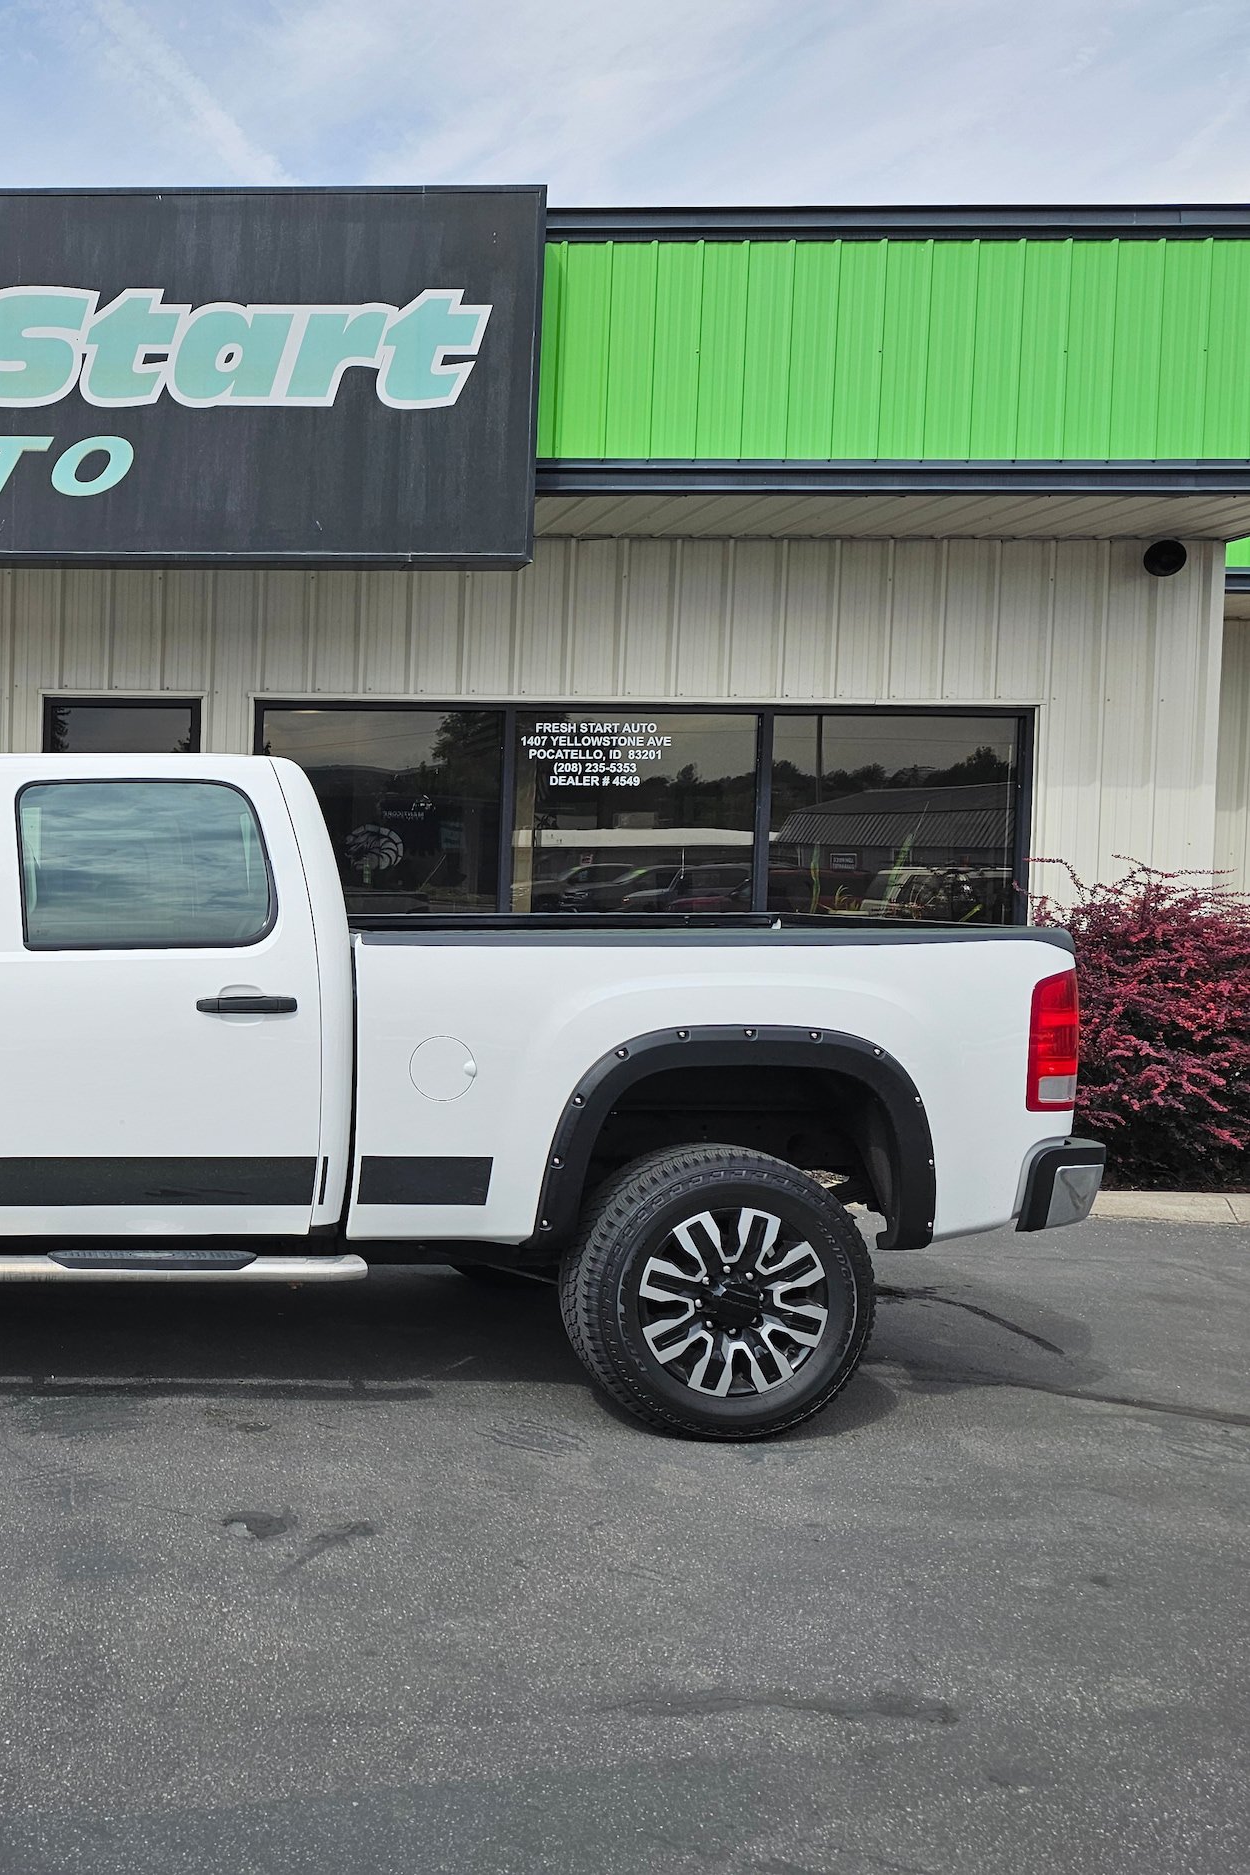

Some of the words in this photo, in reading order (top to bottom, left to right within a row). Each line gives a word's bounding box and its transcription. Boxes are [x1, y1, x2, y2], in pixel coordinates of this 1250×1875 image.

[535, 723, 576, 733] FRESH
[579, 723, 620, 733] START
[621, 723, 657, 733] AUTO
[520, 736, 547, 746] 1407
[550, 736, 644, 746] YELLOWSTONE
[646, 736, 672, 746] AVE
[528, 749, 606, 761] POCATELLO,
[609, 750, 622, 759] ID
[628, 750, 662, 760] 83201
[553, 763, 582, 775] (208)
[585, 763, 637, 773] 235-5353
[549, 776, 599, 786] DEALER
[602, 776, 610, 786] #
[612, 776, 640, 786] 4549
